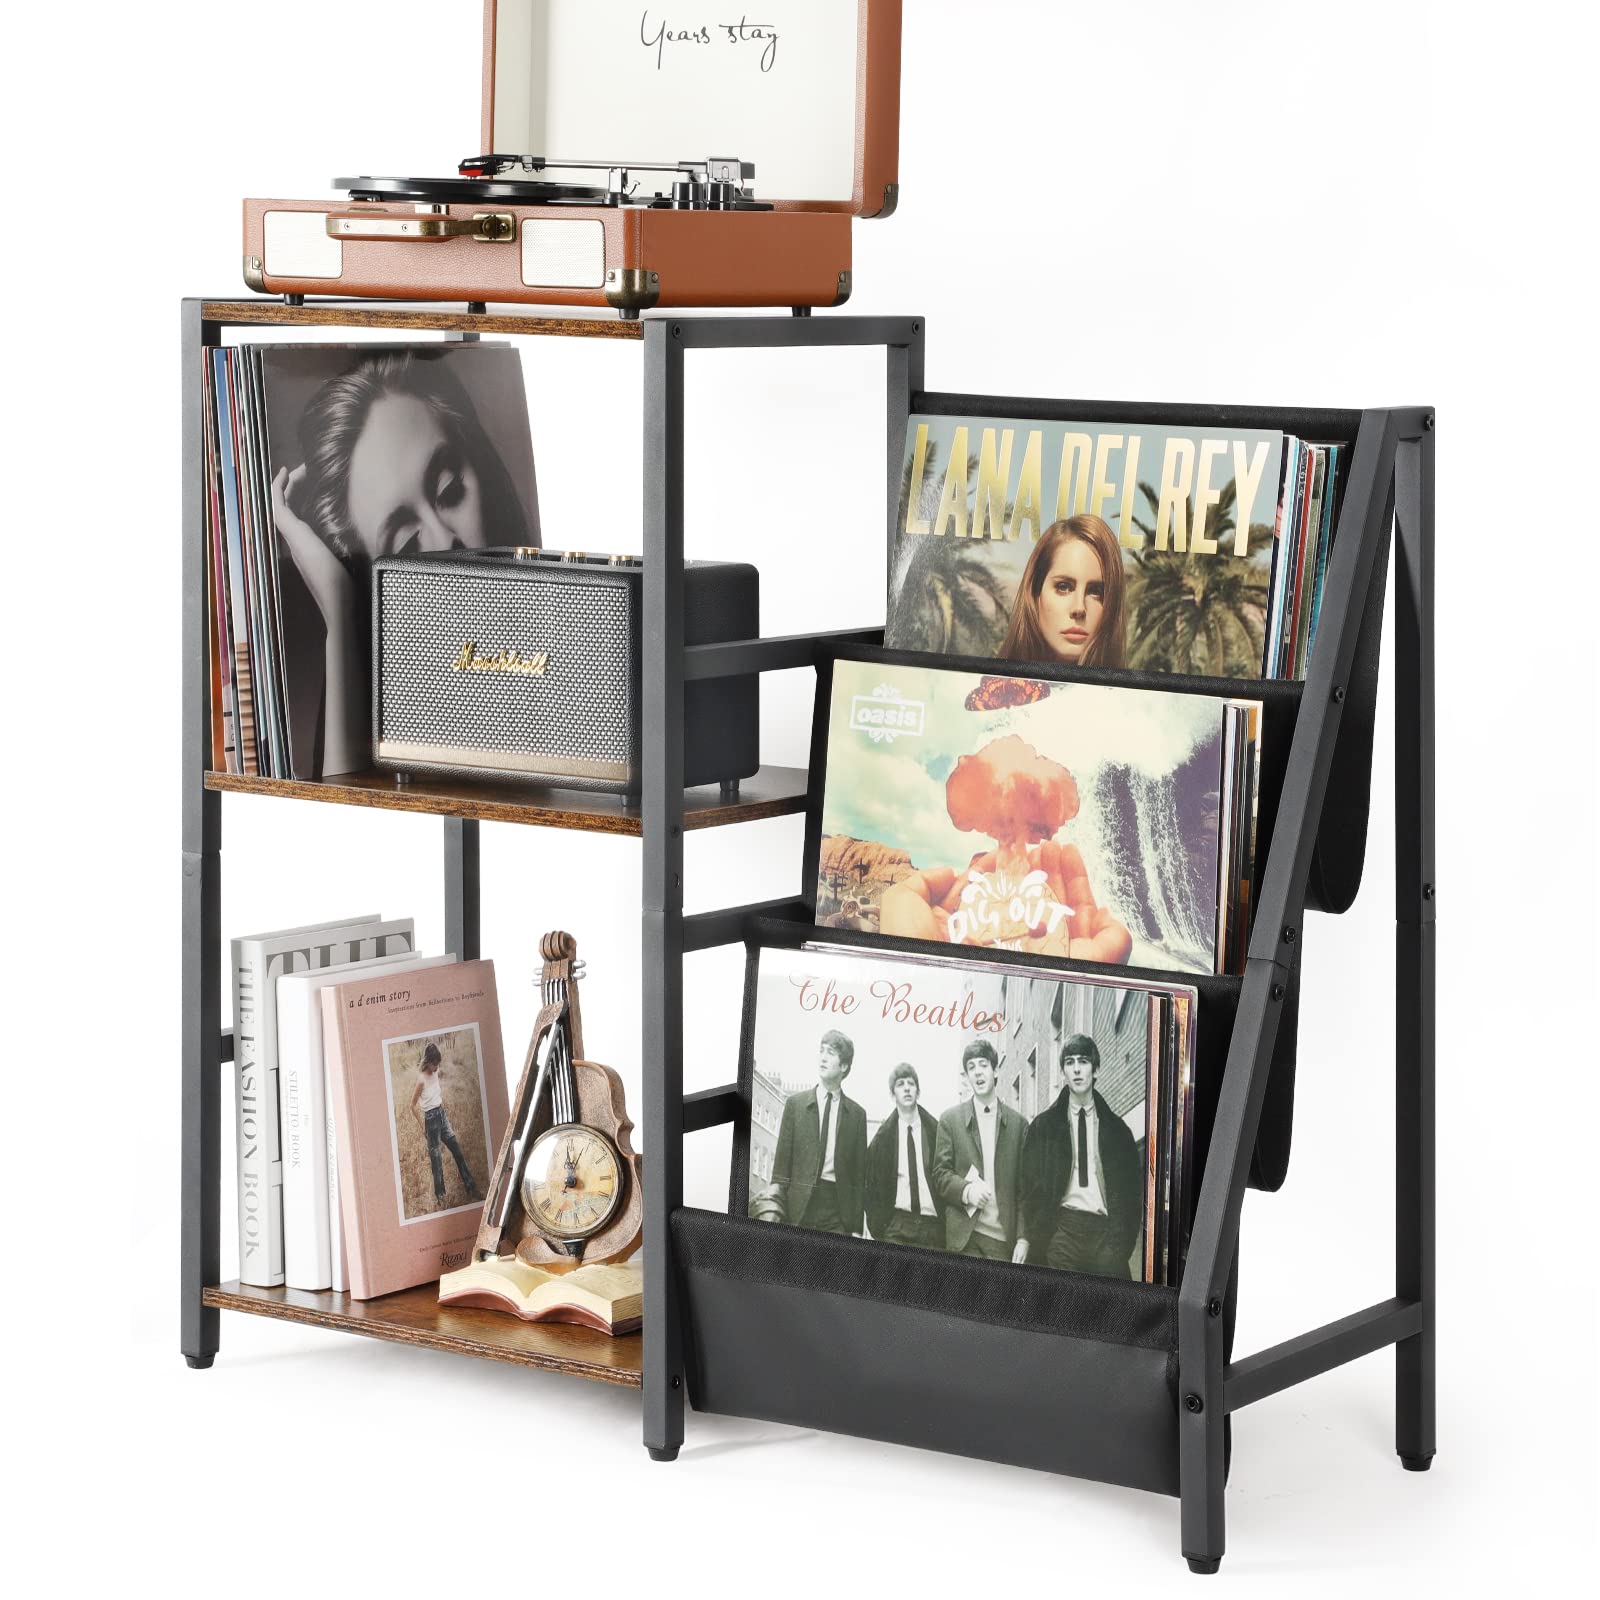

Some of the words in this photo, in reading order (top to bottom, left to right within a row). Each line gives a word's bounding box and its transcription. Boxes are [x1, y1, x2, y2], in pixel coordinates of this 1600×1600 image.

[640, 10, 710, 70] Years
[718, 15, 780, 73] stay
[905, 423, 1042, 542] LANA
[1055, 432, 1143, 551] DEL
[1154, 437, 1270, 558] REY
[857, 705, 917, 727] oasis
[948, 899, 1000, 944] DIG
[1009, 897, 1076, 934] OUT
[239, 961, 255, 1024] THE
[349, 1000, 354, 1008] a
[389, 990, 411, 1002] story
[789, 976, 861, 1015] The
[870, 980, 1010, 1033] Beatles
[241, 1036, 258, 1159] FASHION
[291, 1134, 301, 1168] BOOK
[244, 1172, 260, 1258] BOOK
